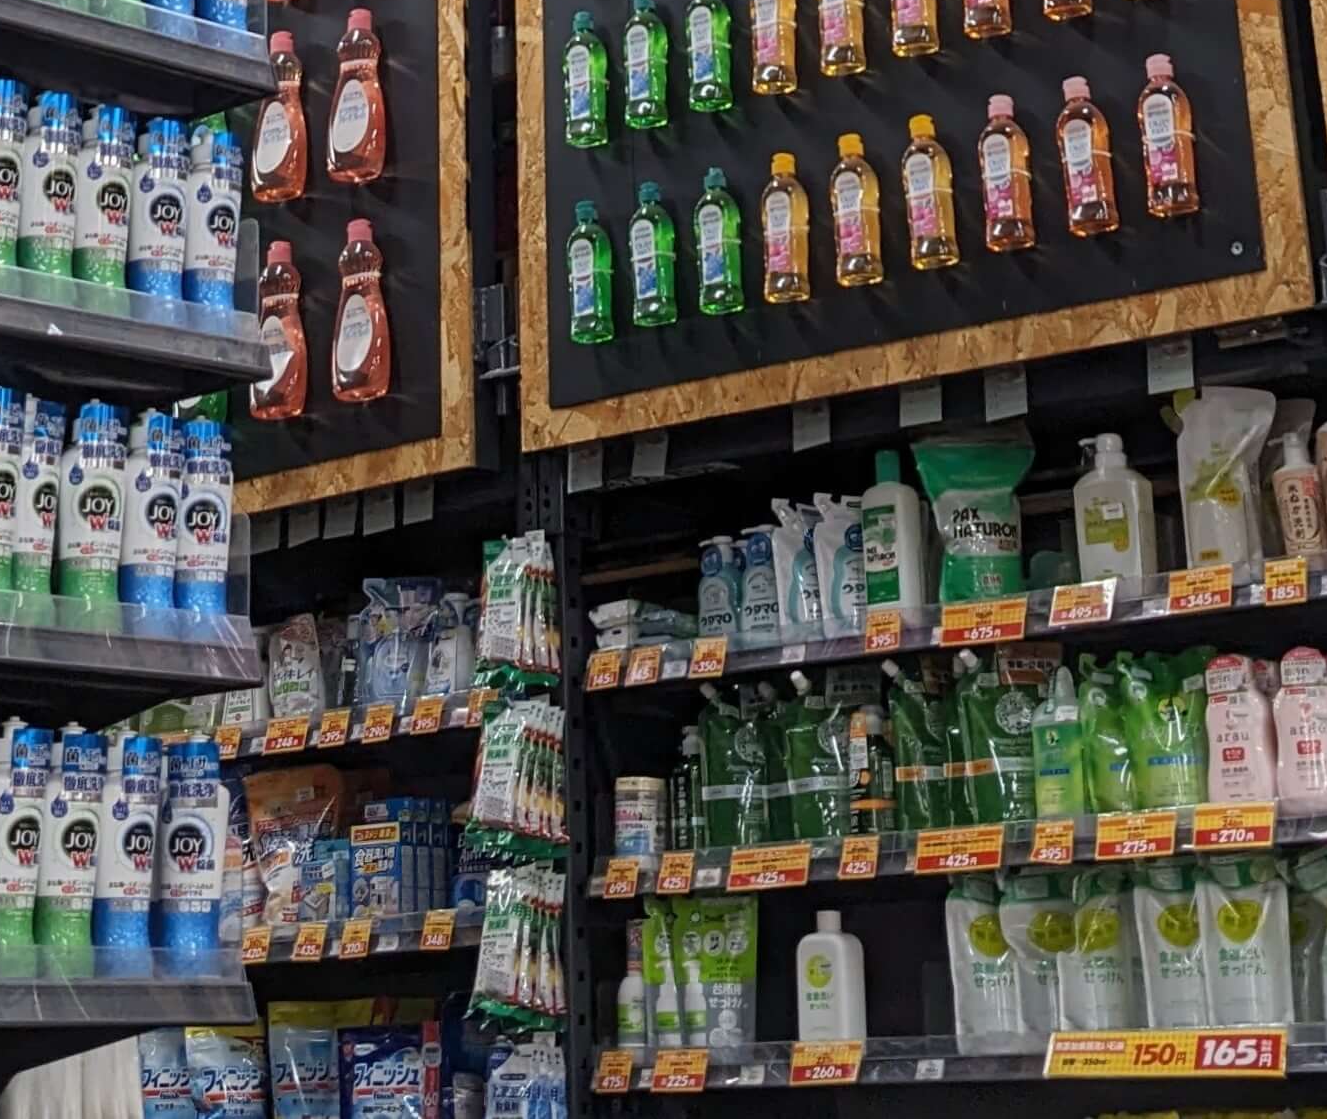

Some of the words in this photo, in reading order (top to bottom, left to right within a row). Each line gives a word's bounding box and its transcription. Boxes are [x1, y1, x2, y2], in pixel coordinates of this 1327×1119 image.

[100, 192, 129, 211] JOY
[153, 204, 182, 223] JOY
[81, 496, 114, 515] JOY
[186, 509, 219, 528] JOY
[11, 830, 40, 847] JOY
[66, 832, 96, 849] JOY
[127, 835, 153, 851] JOY
[172, 837, 202, 854] JOY
